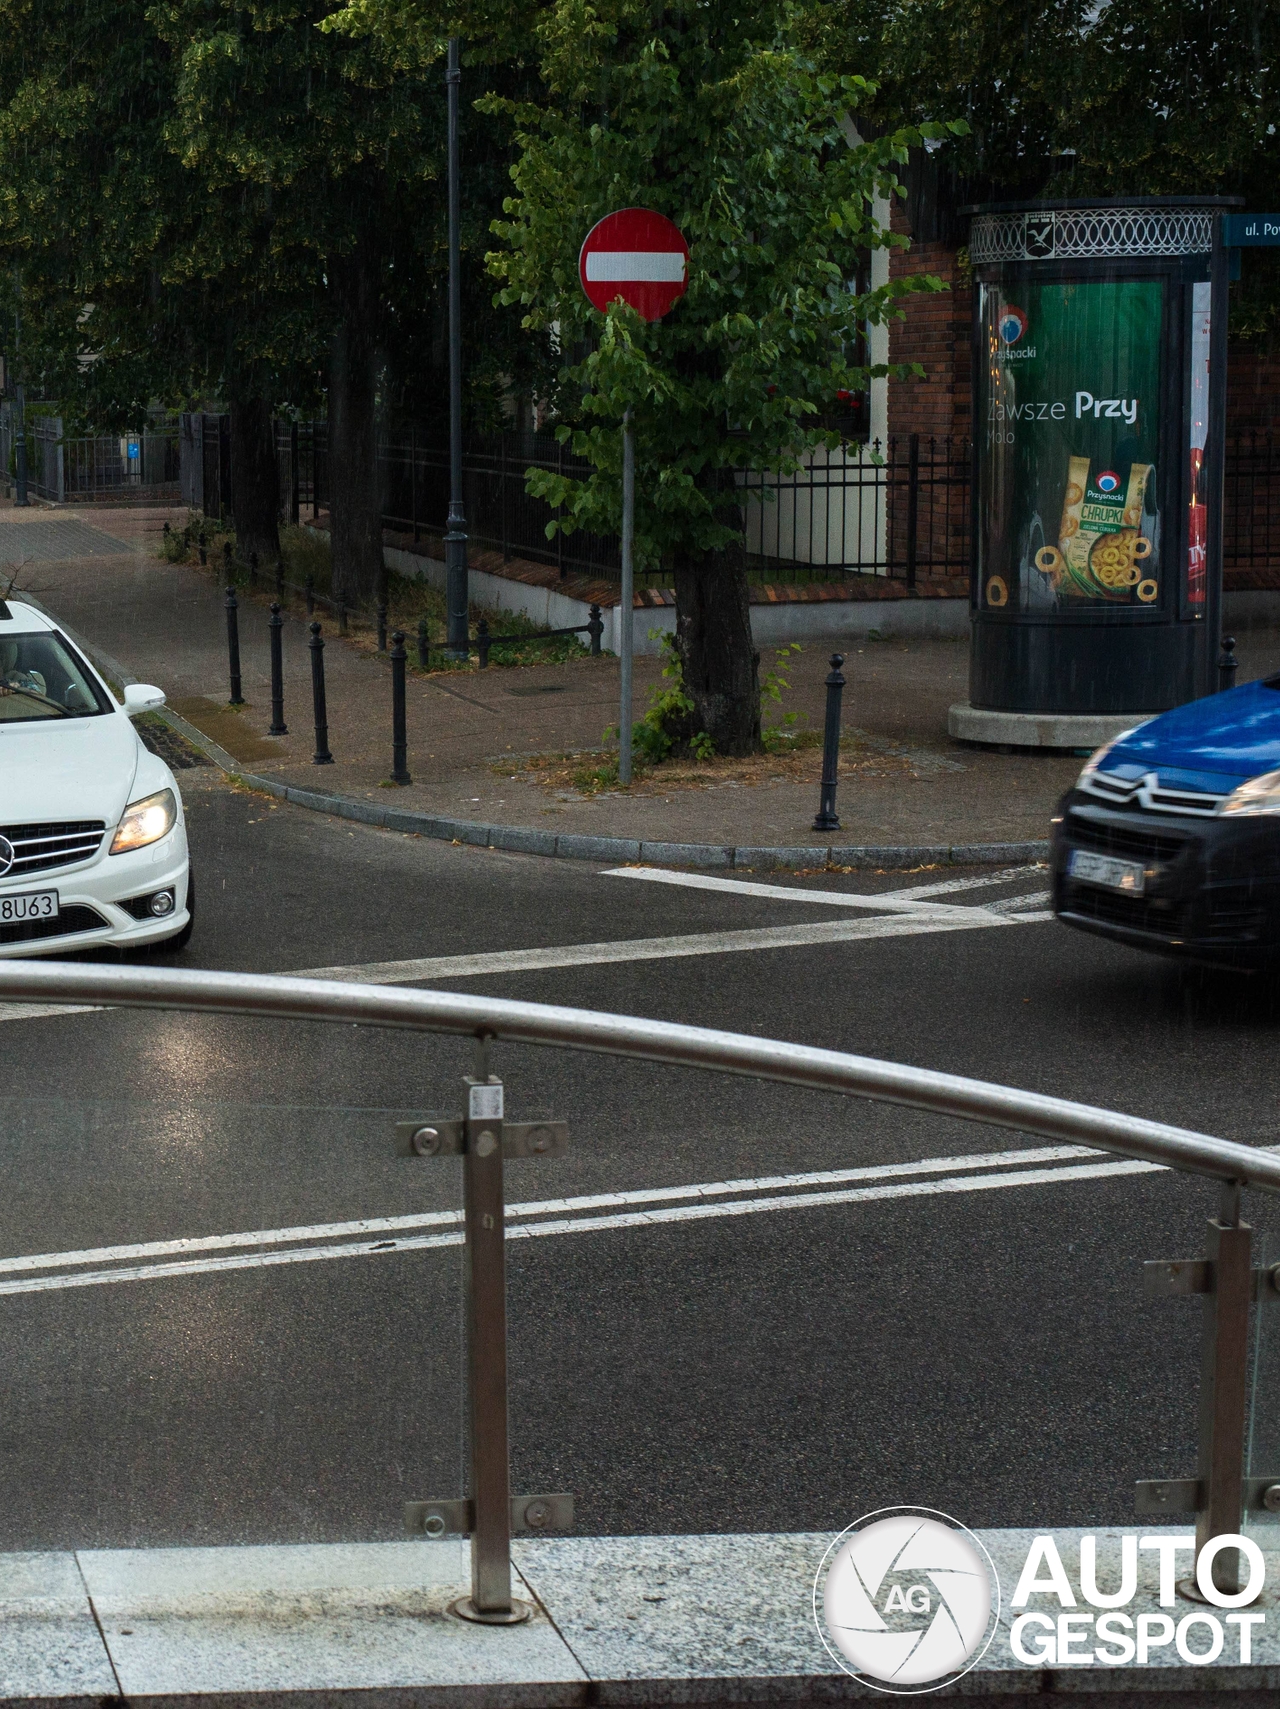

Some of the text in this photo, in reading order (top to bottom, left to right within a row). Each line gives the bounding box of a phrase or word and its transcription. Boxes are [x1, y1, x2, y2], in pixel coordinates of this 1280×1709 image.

[1245, 222, 1259, 236] ul.
[987, 391, 1137, 424] Zawsze Przy
[987, 430, 1015, 445] Molo
[1081, 505, 1124, 523] CHRUPKI
[2, 896, 52, 919] 8U63
